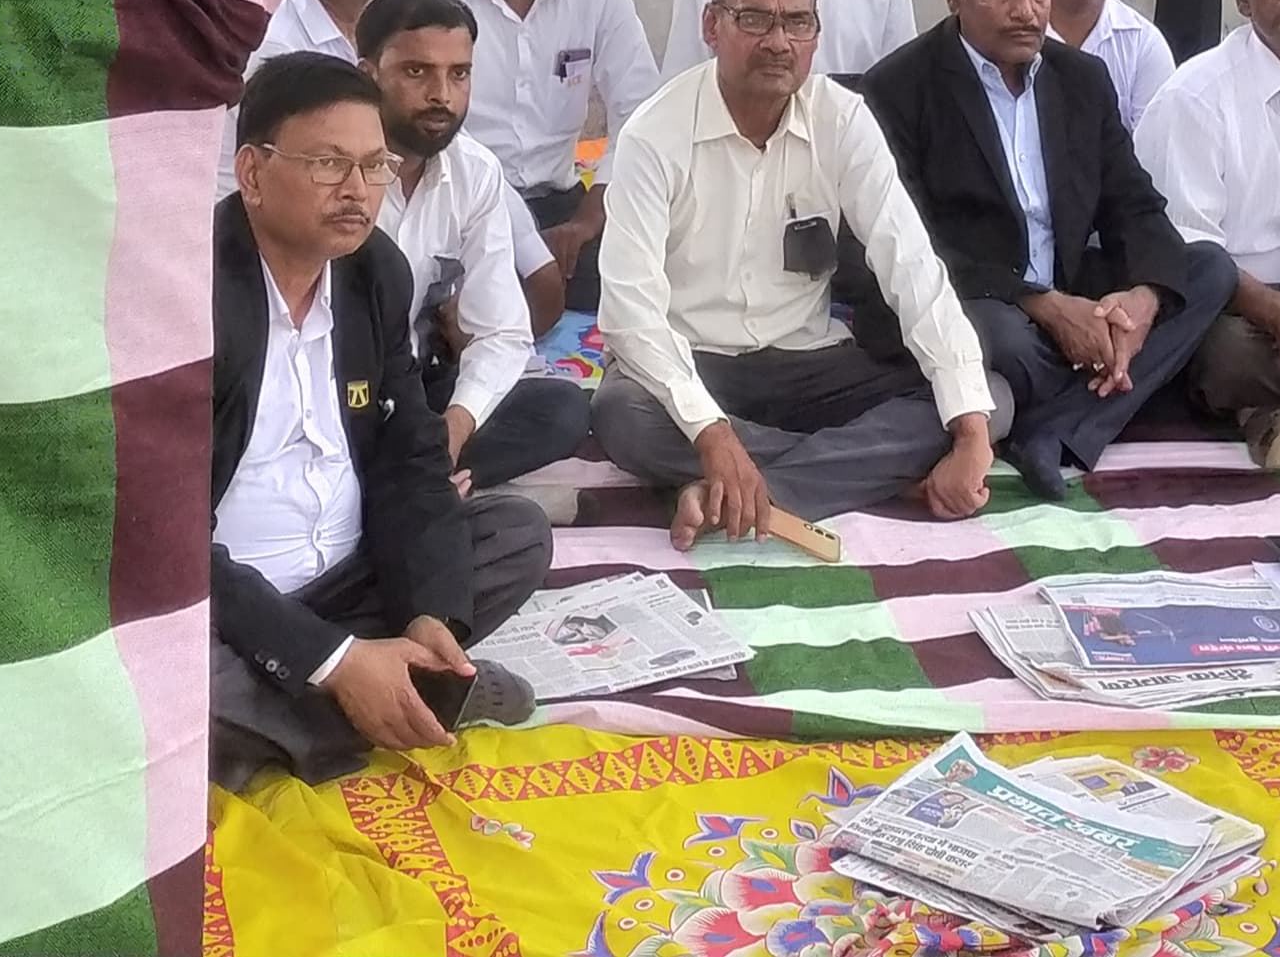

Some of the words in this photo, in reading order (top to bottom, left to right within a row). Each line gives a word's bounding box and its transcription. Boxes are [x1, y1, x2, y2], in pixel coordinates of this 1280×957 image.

[1097, 670, 1181, 692] जागरण
[986, 785, 1067, 823] प्रभात
[1064, 818, 1141, 852] खबर
